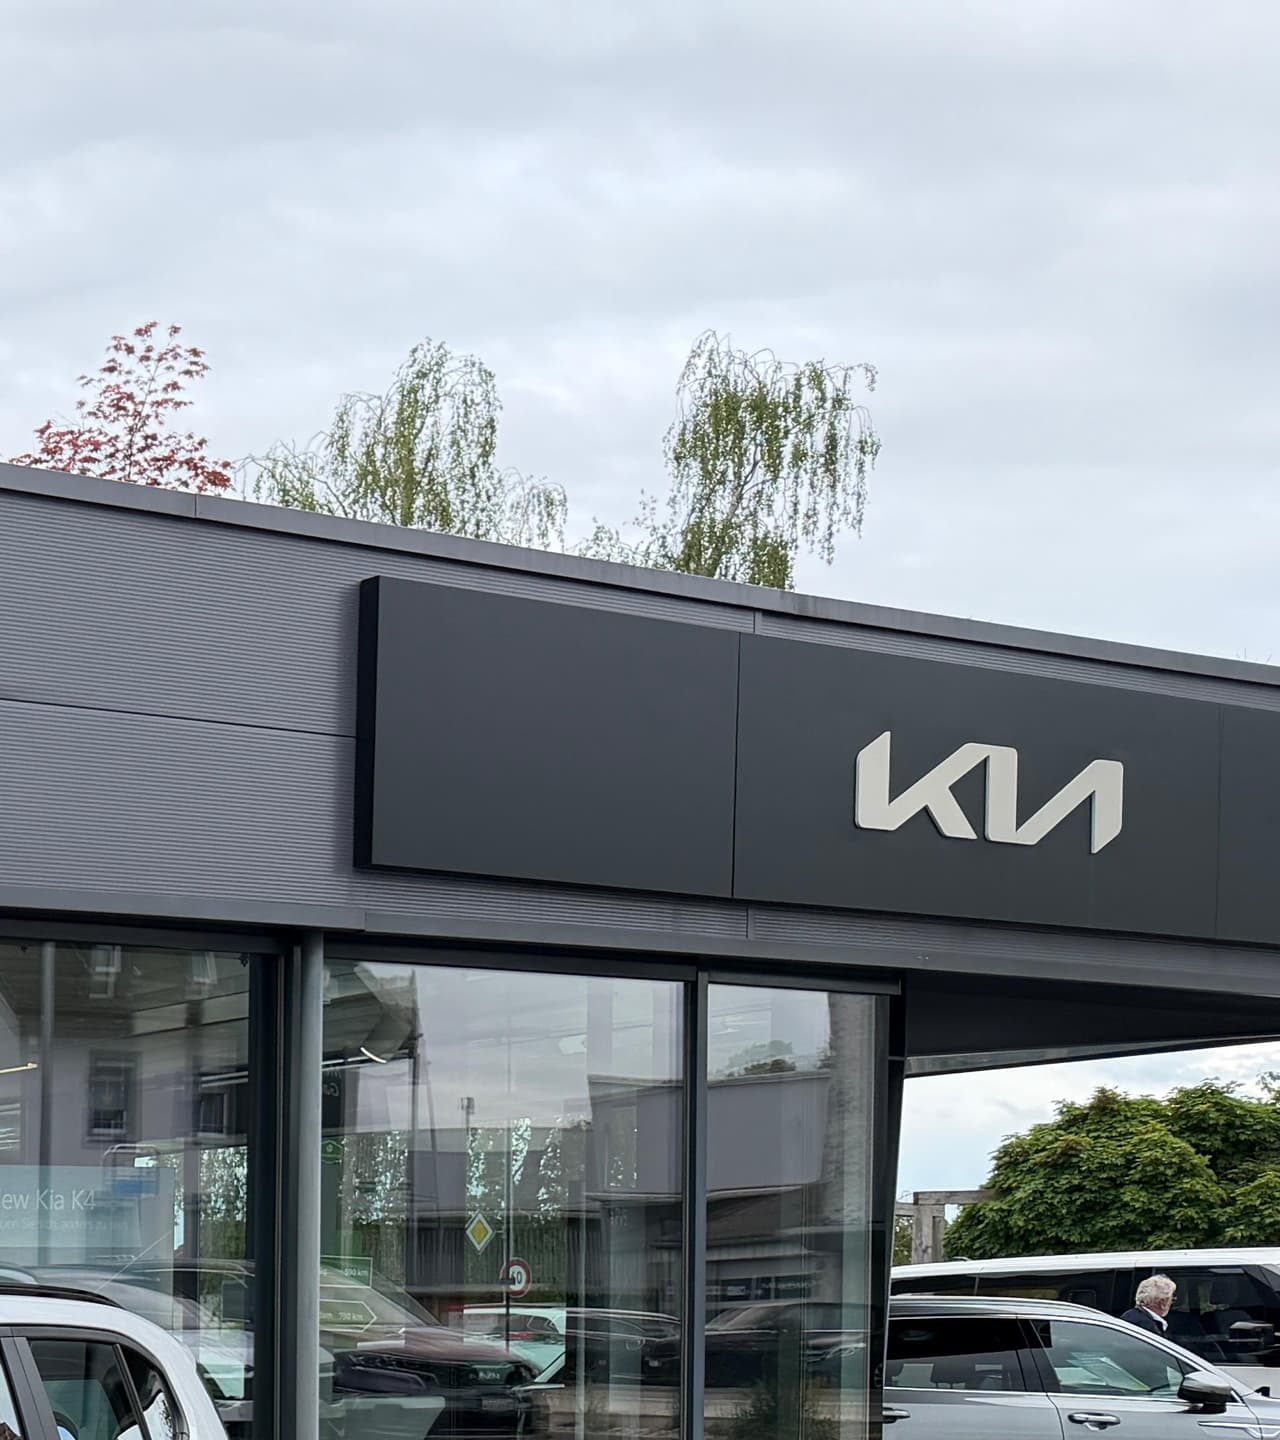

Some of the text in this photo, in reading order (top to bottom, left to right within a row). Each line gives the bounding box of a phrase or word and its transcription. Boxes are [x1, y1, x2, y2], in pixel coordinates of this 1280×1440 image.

[855, 731, 1124, 854] KIA
[36, 1187, 65, 1211] Kia
[71, 1187, 97, 1211] K4
